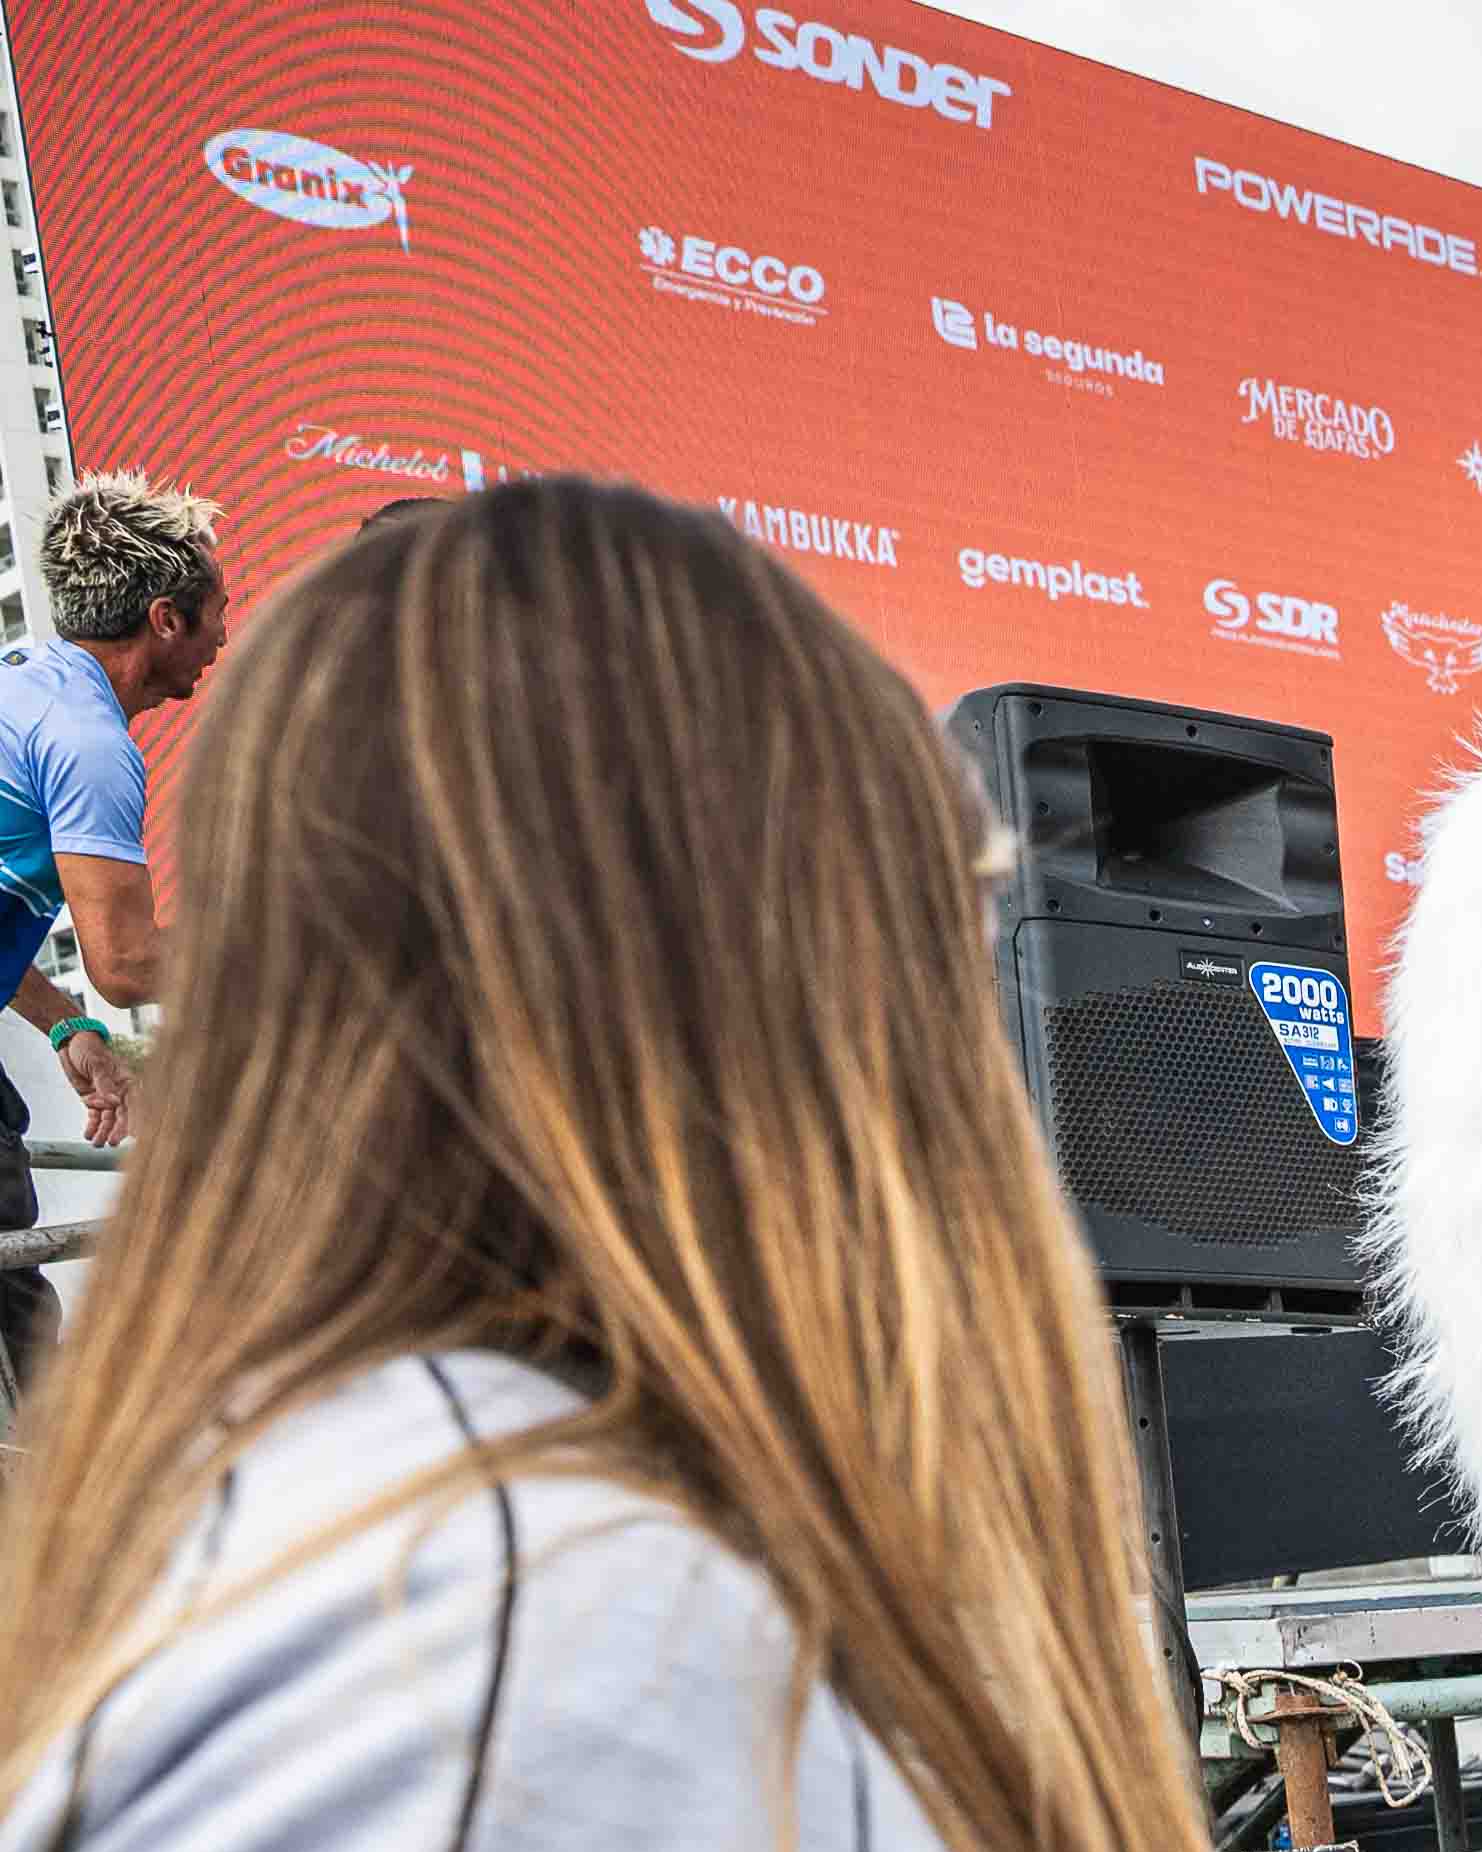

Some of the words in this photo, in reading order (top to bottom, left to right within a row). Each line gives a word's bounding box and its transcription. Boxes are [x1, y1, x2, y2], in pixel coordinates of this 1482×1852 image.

[222, 148, 368, 208] Granix
[1194, 156, 1479, 277] POWERADE
[681, 235, 825, 304] ECCO
[984, 312, 1018, 350] la
[1024, 330, 1164, 385] segunda
[1238, 377, 1395, 455] MERCADO
[1274, 416, 1299, 441] DE
[287, 424, 449, 481] Michelob
[958, 548, 1147, 607] gemplast
[1256, 592, 1339, 645] SDR
[1262, 972, 1338, 1009] 2000
[1300, 1007, 1345, 1024] watts
